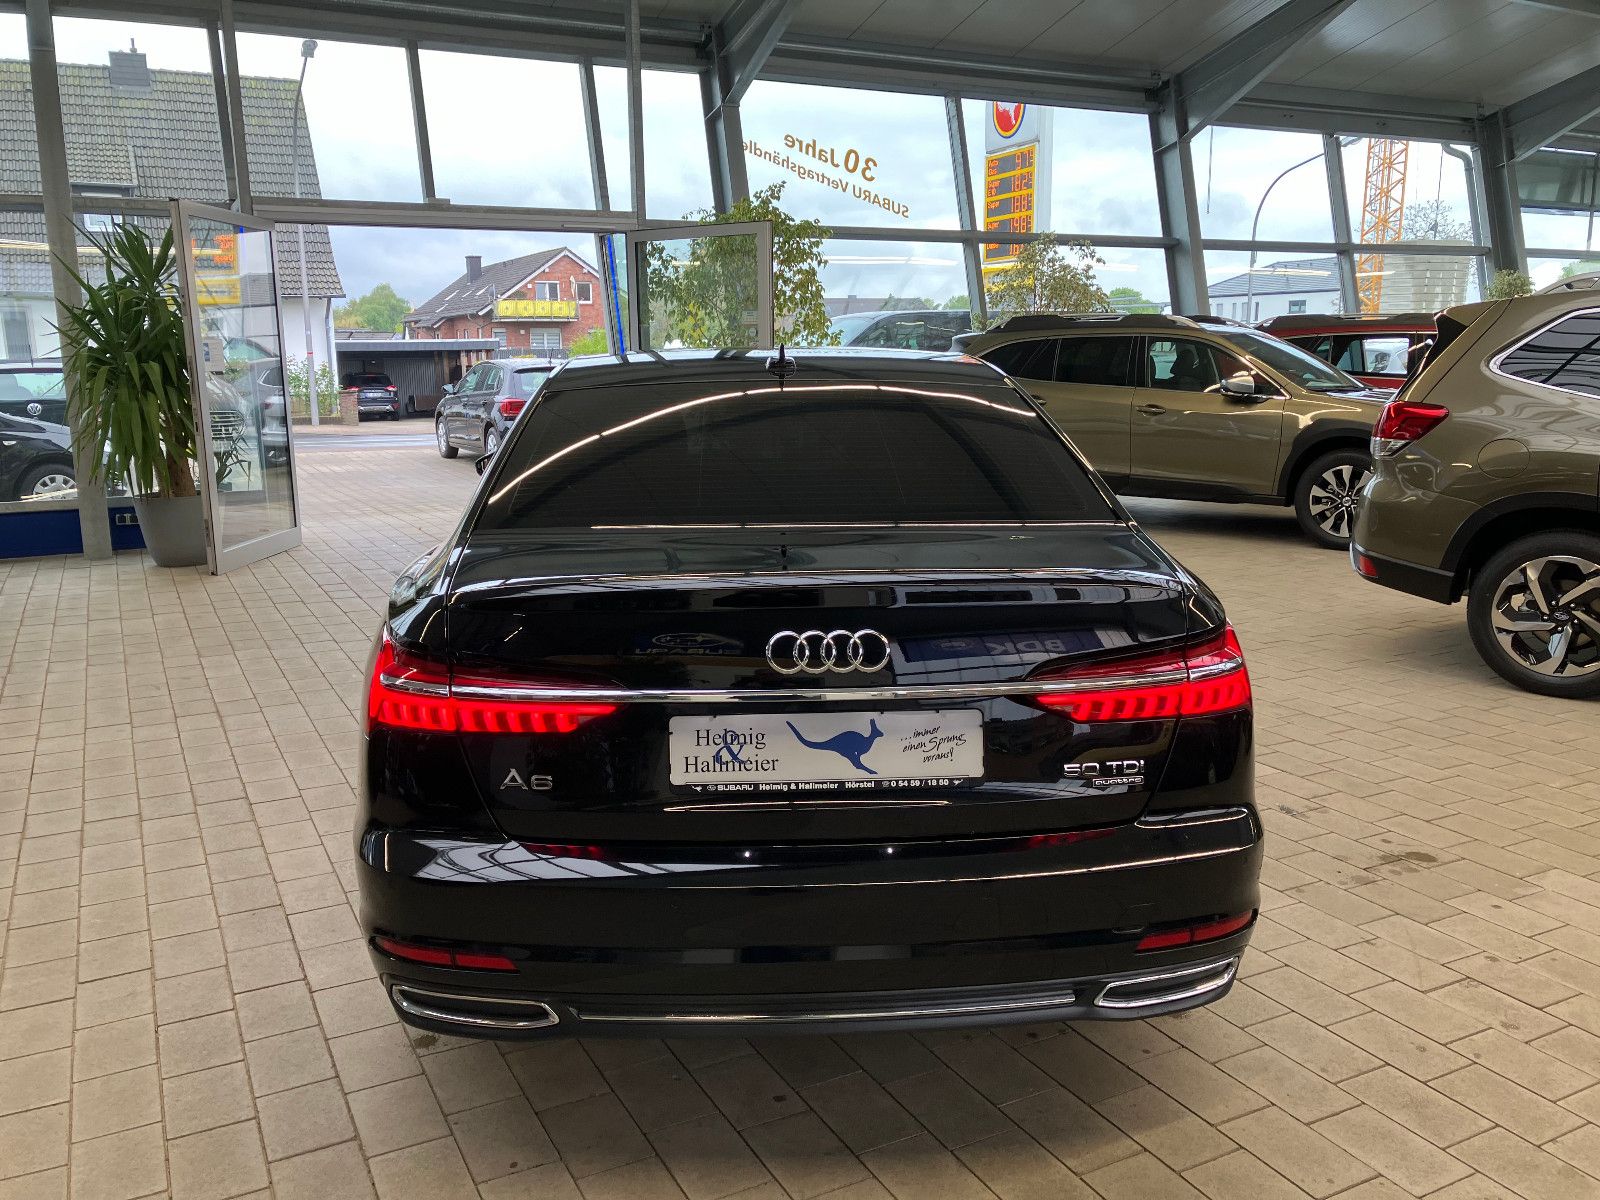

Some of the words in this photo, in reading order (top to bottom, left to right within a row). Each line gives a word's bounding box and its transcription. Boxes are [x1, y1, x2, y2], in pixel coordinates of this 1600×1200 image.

[694, 727, 767, 750] Helmig
[714, 729, 749, 766] &
[902, 741, 927, 753] einen
[922, 733, 967, 753] Sprung
[683, 754, 779, 774] Hallmeier
[922, 747, 955, 763] voraus!
[1063, 762, 1100, 777] 50
[1105, 759, 1145, 775] TDI
[499, 768, 553, 790] A6
[759, 783, 788, 792] Helmig
[799, 781, 839, 790] Hallmeier
[845, 780, 875, 789] Hörstel
[1094, 777, 1143, 786] quattro
